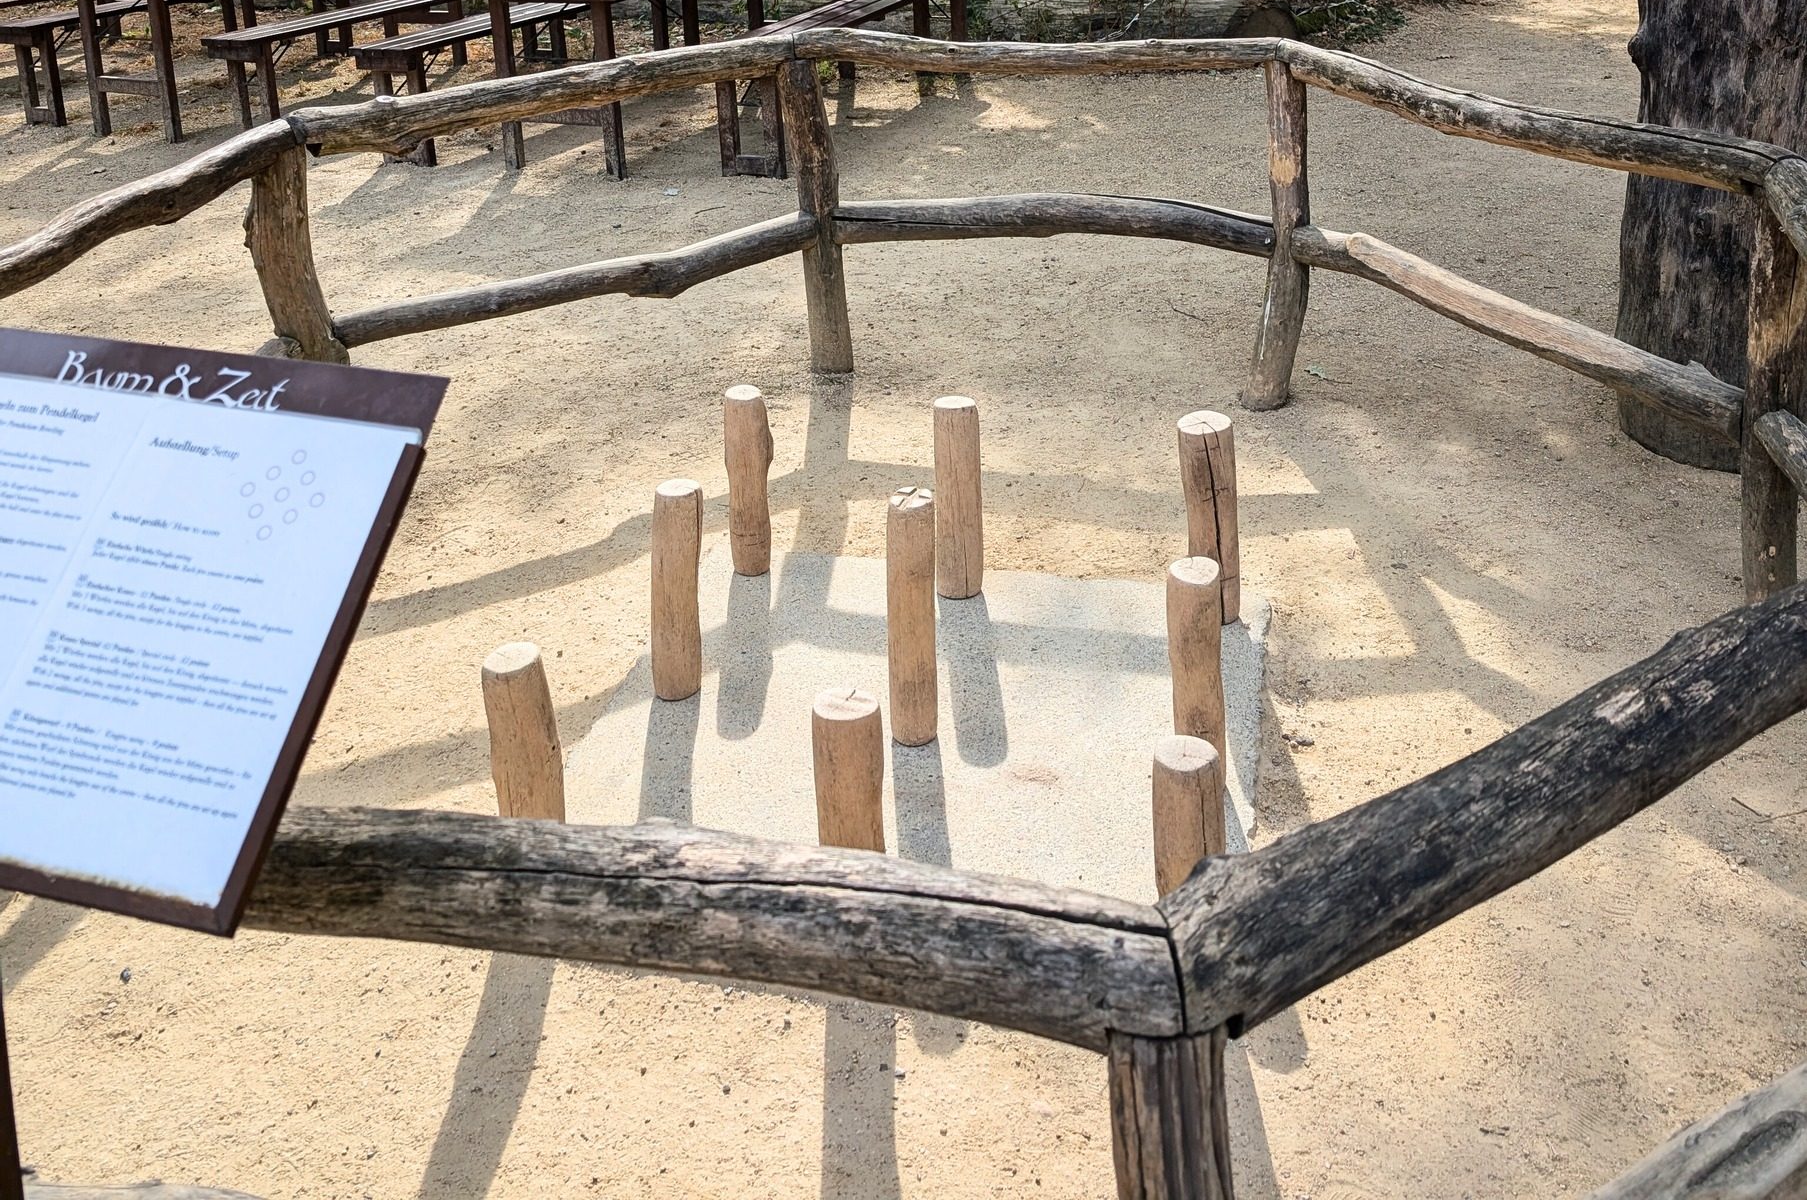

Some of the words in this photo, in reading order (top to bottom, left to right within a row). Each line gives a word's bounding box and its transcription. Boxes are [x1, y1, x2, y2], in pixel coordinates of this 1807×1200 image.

[57, 350, 154, 393] Baum
[158, 361, 202, 402] &
[203, 366, 291, 412] Zeit
